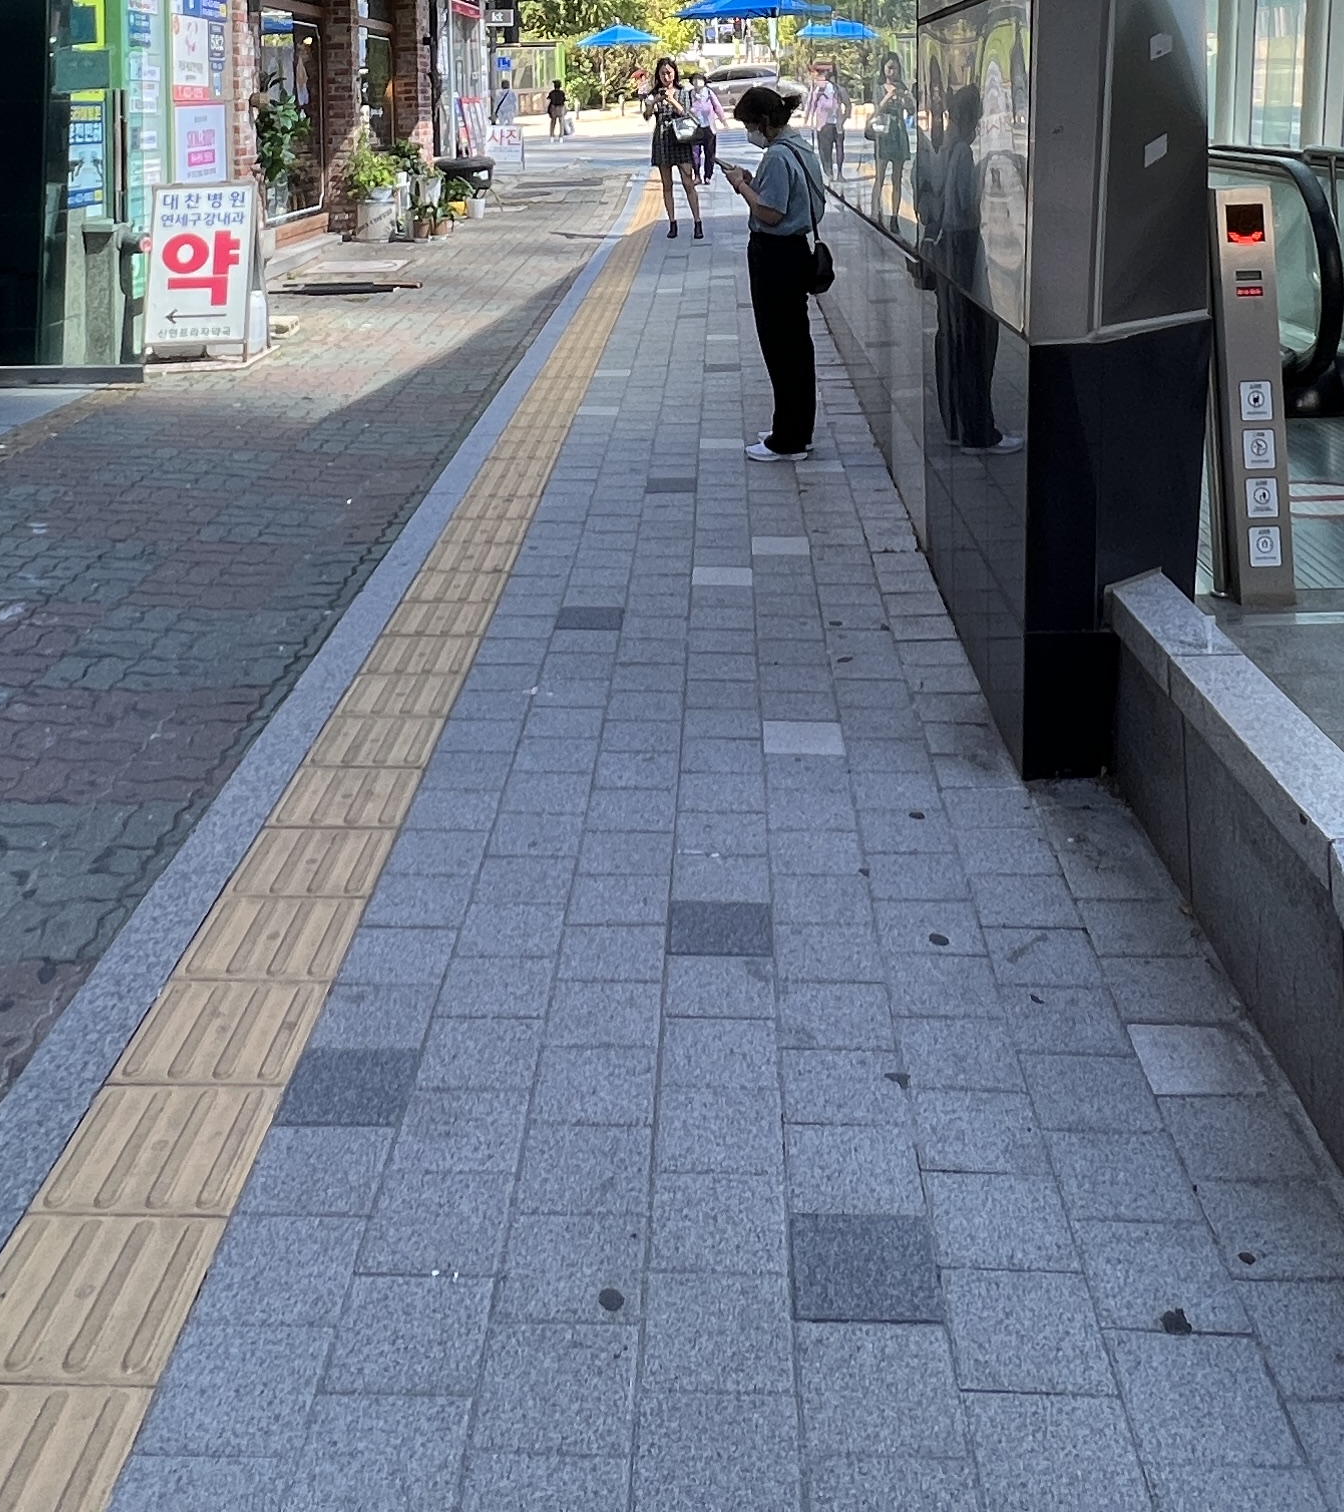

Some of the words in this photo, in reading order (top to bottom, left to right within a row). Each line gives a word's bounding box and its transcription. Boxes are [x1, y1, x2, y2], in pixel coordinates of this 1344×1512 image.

[491, 11, 505, 22] kt
[487, 128, 522, 146] 사진
[162, 191, 246, 210] 대찬병원
[161, 211, 246, 227] 연세구강내과
[162, 230, 241, 306] 약
